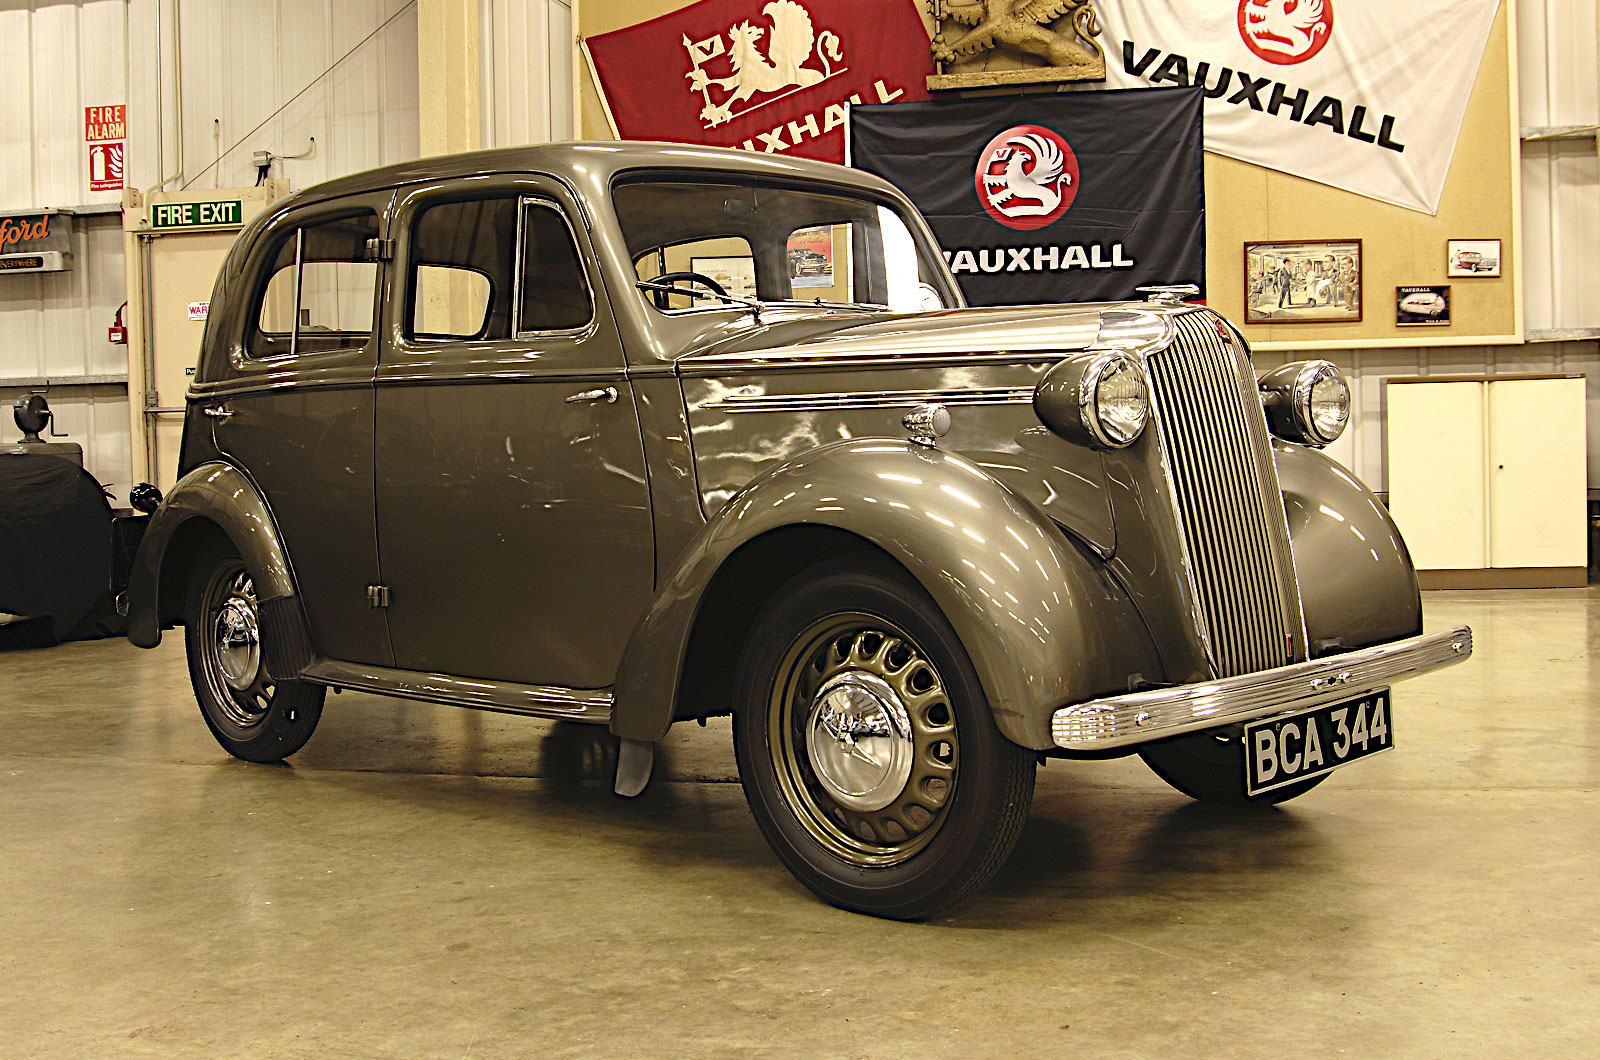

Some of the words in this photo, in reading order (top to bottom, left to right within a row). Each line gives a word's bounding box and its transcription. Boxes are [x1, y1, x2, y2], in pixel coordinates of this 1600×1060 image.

[1123, 40, 1405, 153] VAUXHALL
[90, 106, 121, 124] FIRE
[87, 122, 125, 141] ALARM
[157, 205, 193, 226] FIRE
[200, 202, 237, 223] EXIT
[188, 306, 210, 315] WAR
[1255, 717, 1324, 784] BCA
[1331, 697, 1387, 759] 344
